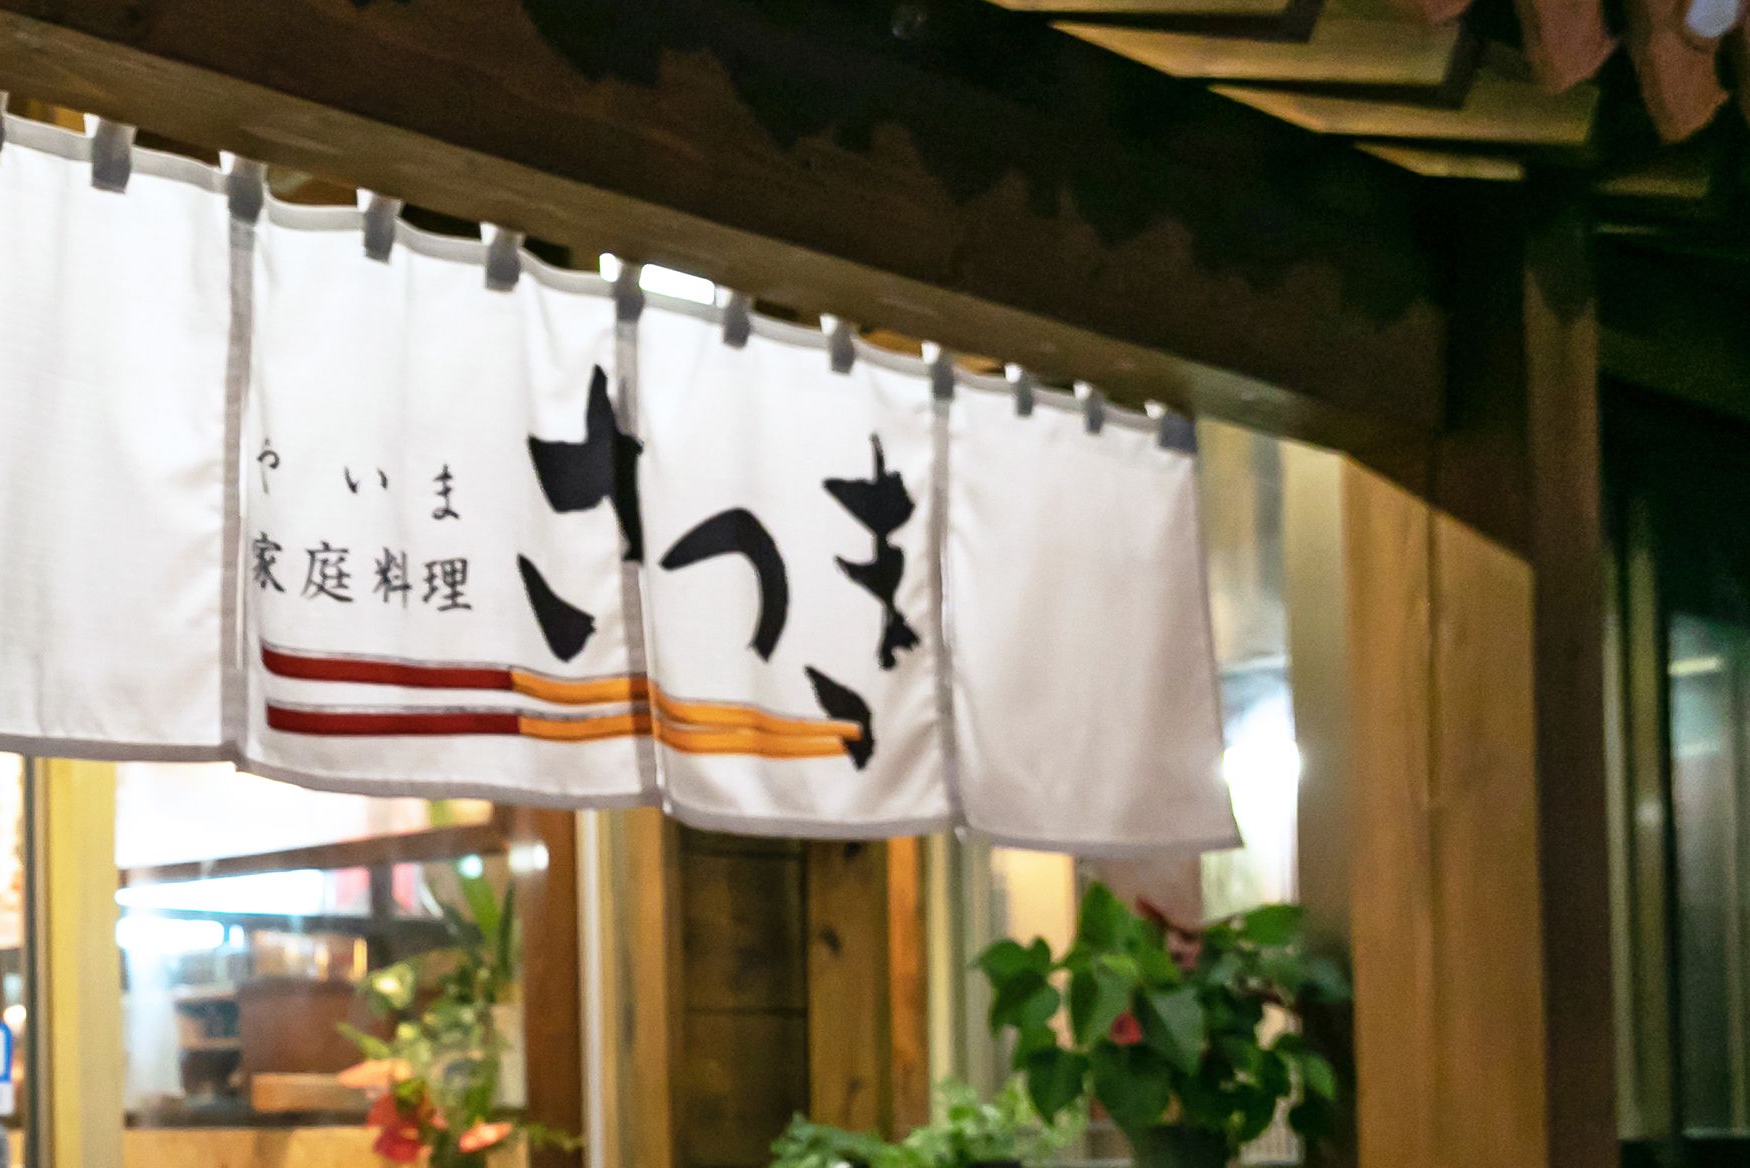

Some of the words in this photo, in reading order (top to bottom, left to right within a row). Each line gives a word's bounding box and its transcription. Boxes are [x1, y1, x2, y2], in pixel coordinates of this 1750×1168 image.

[256, 438, 461, 521] やいま
[252, 531, 474, 612] 家庭料理
[518, 364, 921, 770] さつき
